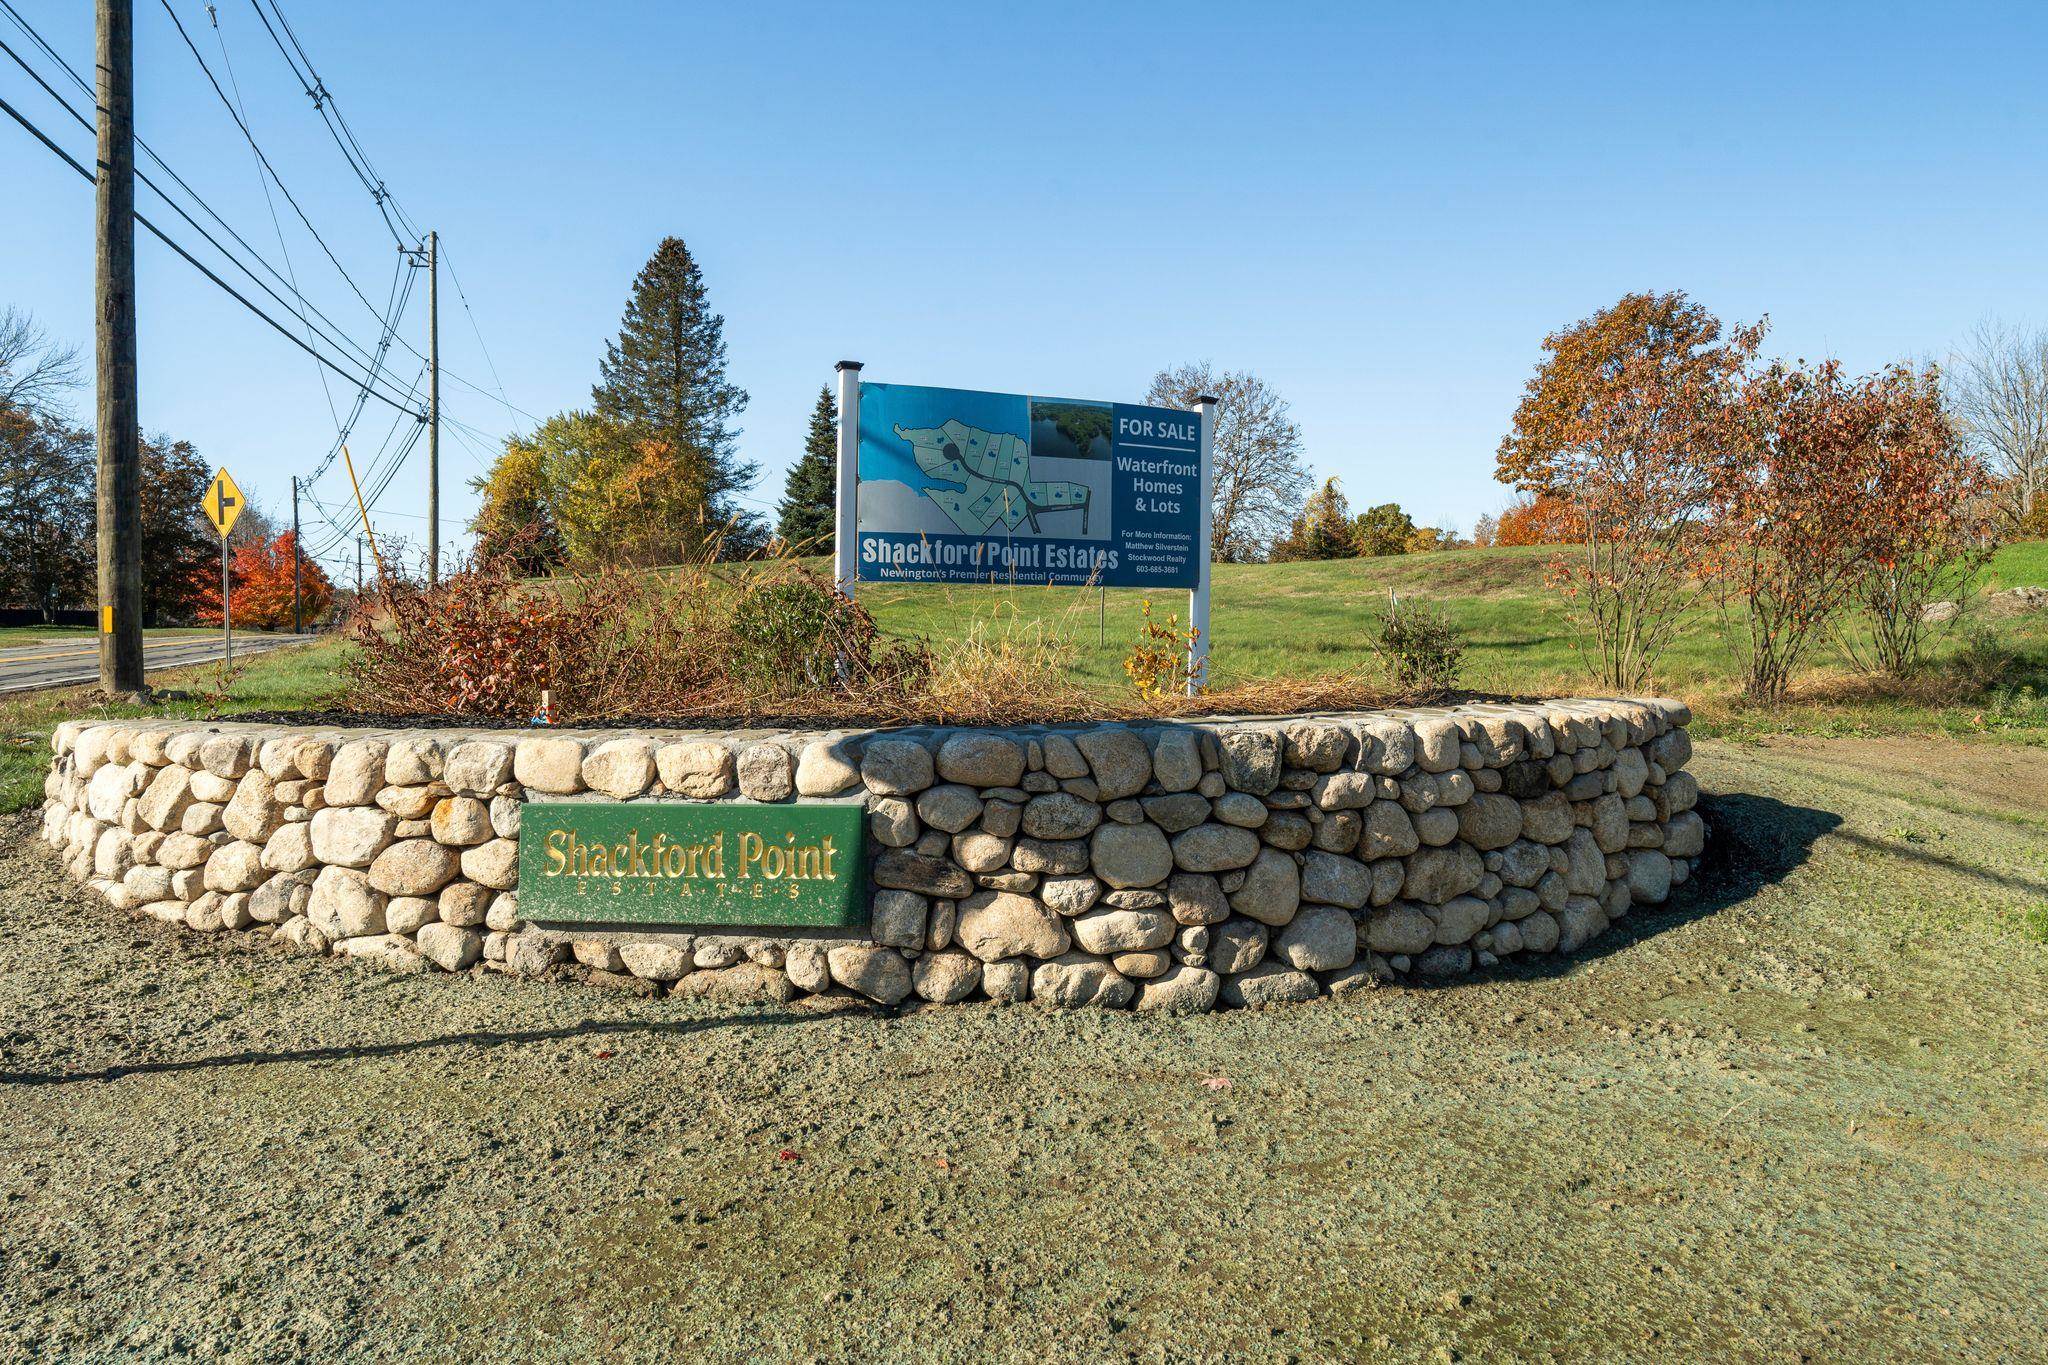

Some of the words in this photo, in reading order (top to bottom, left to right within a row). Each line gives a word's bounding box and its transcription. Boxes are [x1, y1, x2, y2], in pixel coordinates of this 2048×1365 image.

[1119, 418, 1154, 437] FOR
[1158, 421, 1196, 441] SALE
[1116, 456, 1198, 477] Waterfront
[1133, 477, 1183, 495] Homes
[1135, 497, 1147, 512] &
[1150, 498, 1181, 514] Lots
[1121, 530, 1134, 538] For
[1135, 530, 1152, 539] More
[1153, 531, 1192, 541] Information:
[862, 538, 985, 566] Shackford
[987, 542, 1040, 568] Point
[1045, 543, 1119, 570] Estates
[1125, 542, 1154, 550] Matthew
[1155, 542, 1189, 552] Silverstein
[1127, 553, 1165, 562] Stockwood
[1166, 554, 1187, 564] Realty
[949, 569, 990, 579] Premier
[543, 828, 726, 879] Shackford
[737, 831, 838, 881] Point
